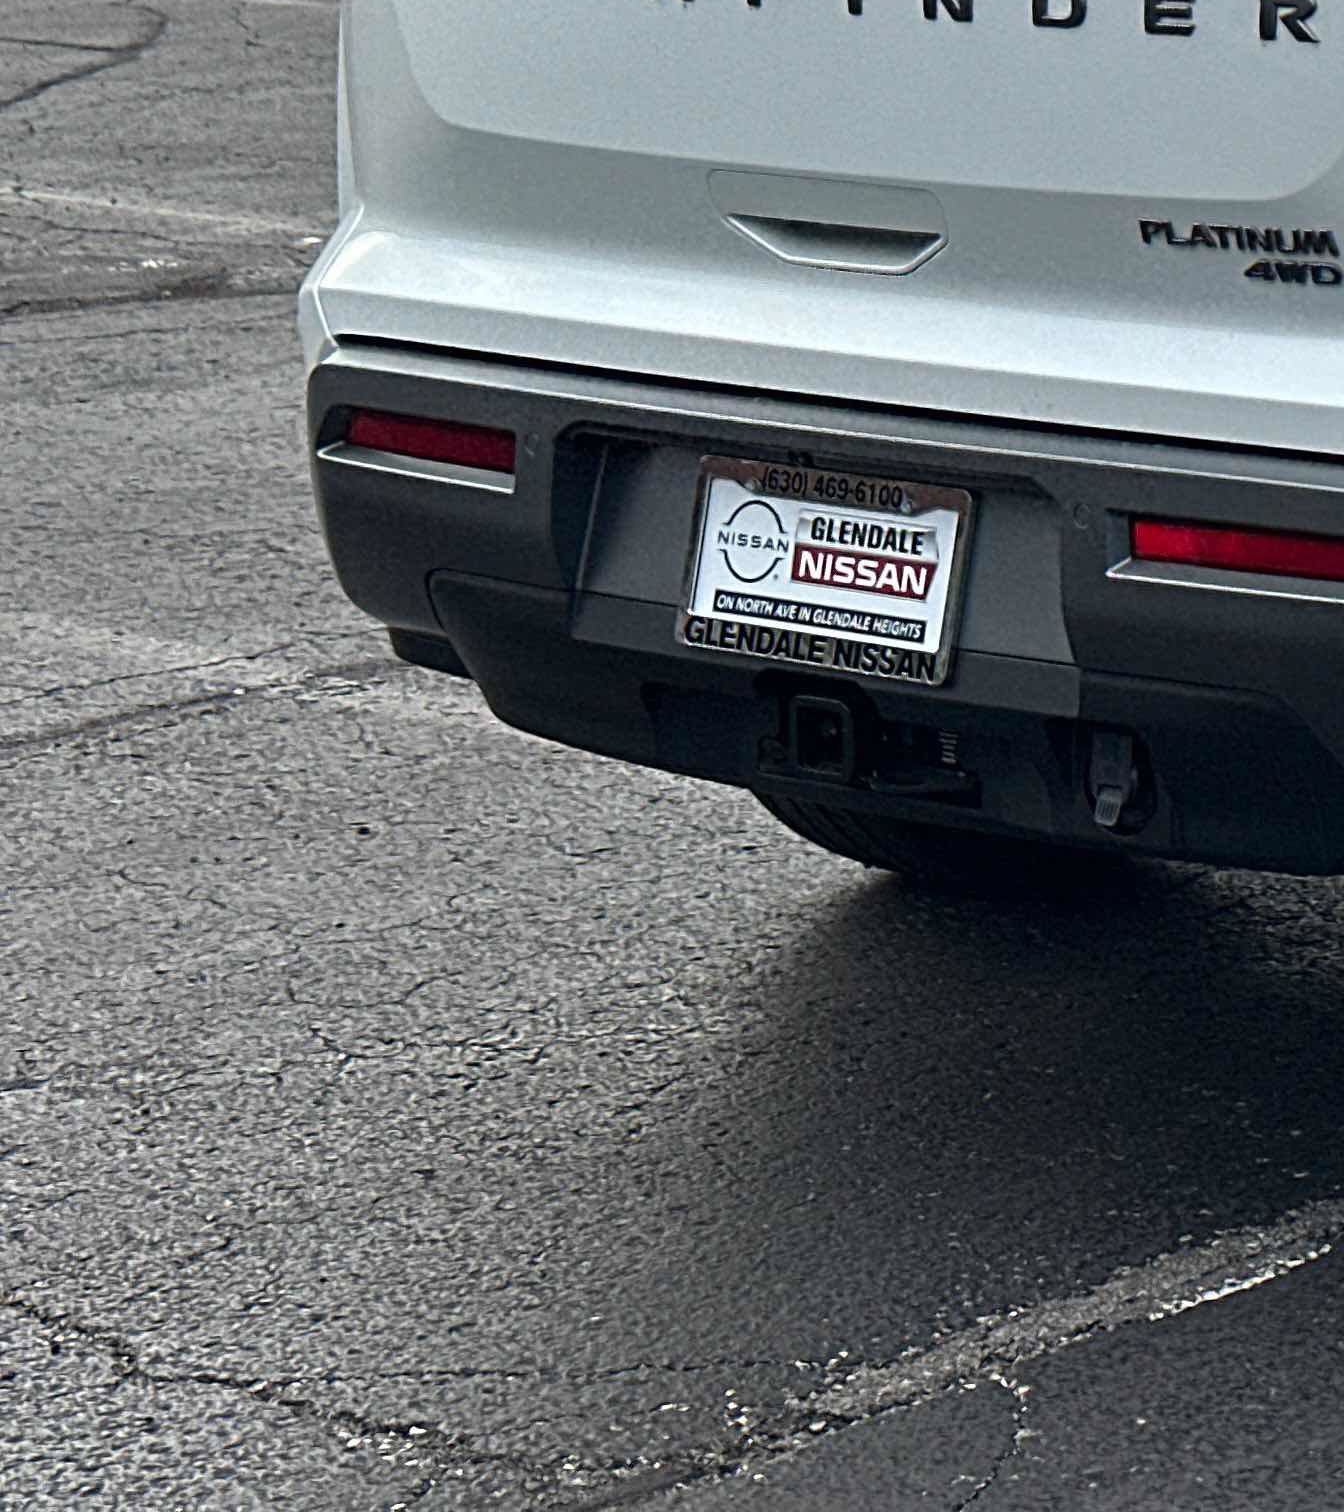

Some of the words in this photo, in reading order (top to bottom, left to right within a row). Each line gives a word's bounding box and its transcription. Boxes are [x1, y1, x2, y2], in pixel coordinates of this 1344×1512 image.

[1137, 217, 1340, 258] PLATINUM
[1243, 258, 1344, 285] 4WD
[813, 475, 902, 508] 469-6100
[716, 529, 789, 553] NISSAN
[811, 516, 925, 556] GLENDALE
[798, 550, 928, 596] NISSAN
[716, 594, 736, 609] ON
[735, 596, 774, 616] NORTH
[774, 604, 798, 620] AVE
[798, 606, 810, 622] IN
[813, 608, 871, 632] GLENDALE
[873, 618, 922, 639] HEIGHTS
[684, 615, 825, 664] GLENDALE
[831, 637, 938, 683] NISSAN
